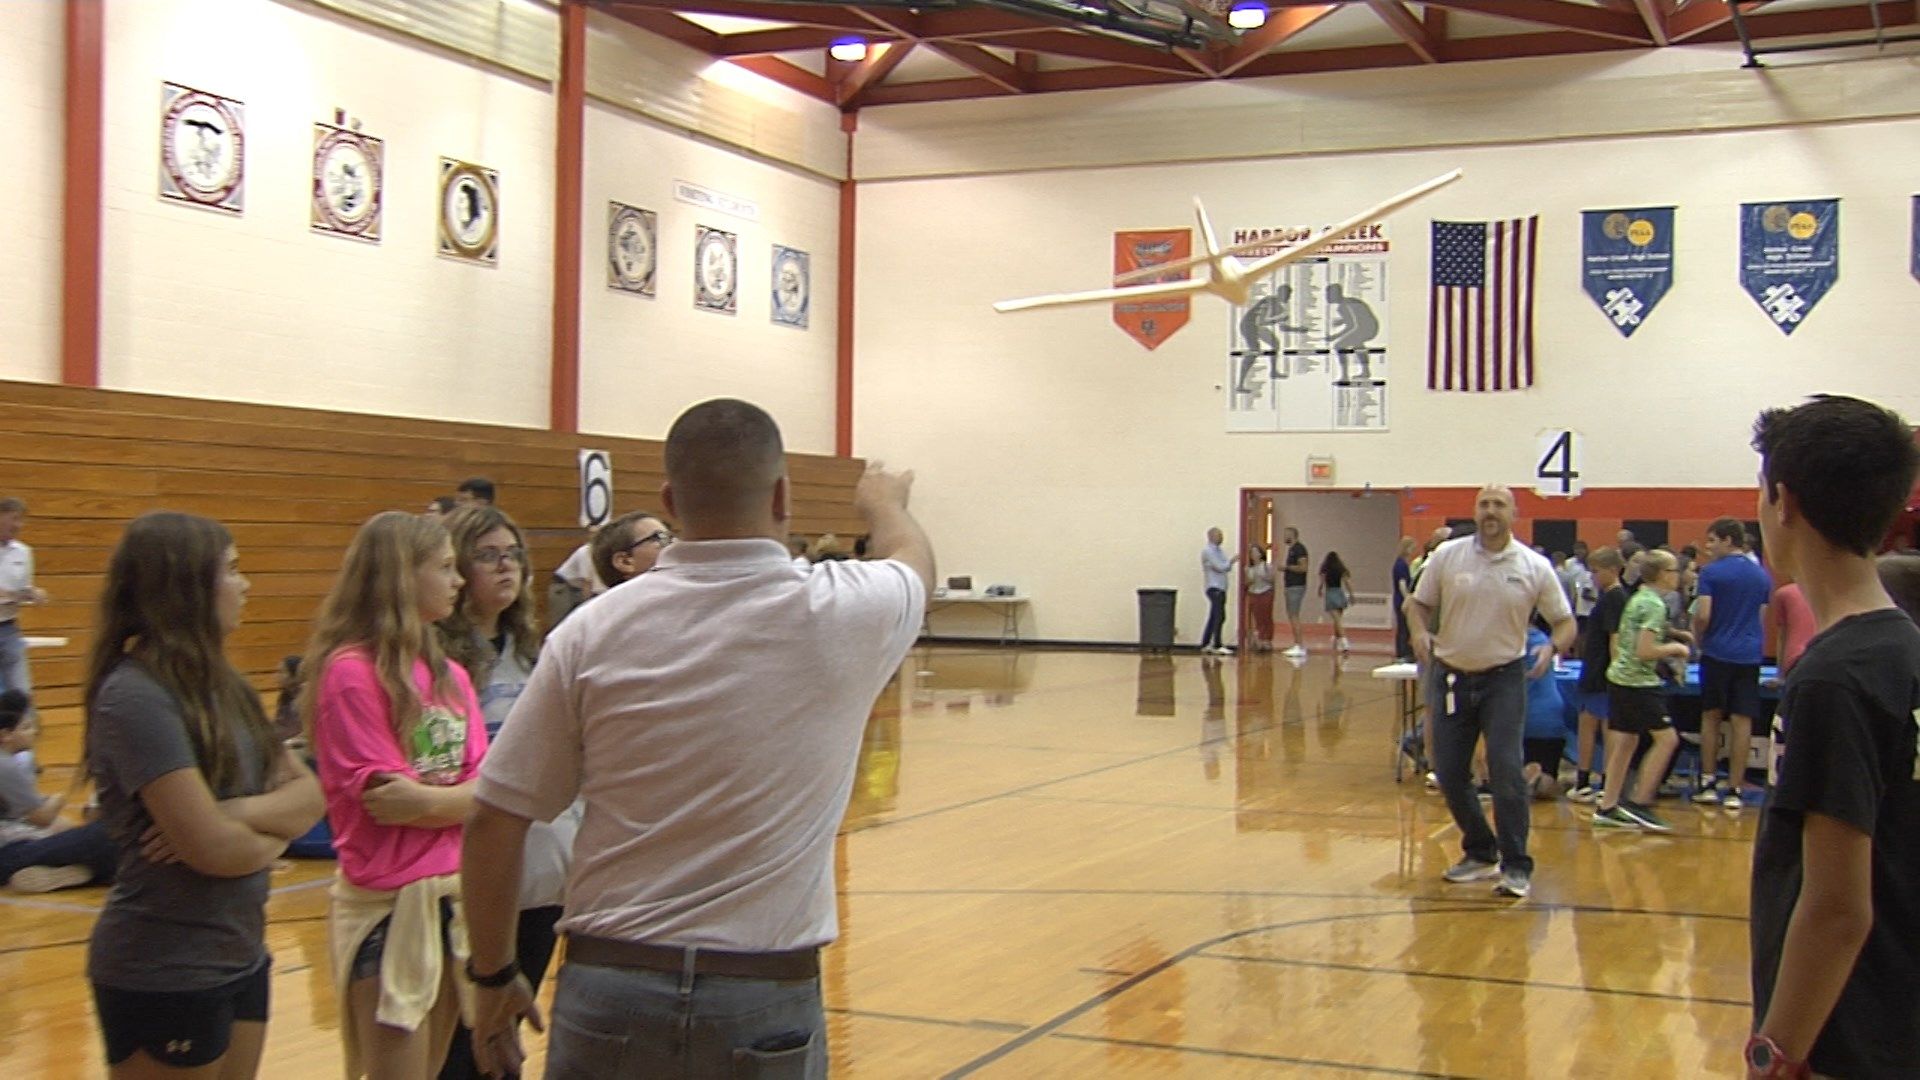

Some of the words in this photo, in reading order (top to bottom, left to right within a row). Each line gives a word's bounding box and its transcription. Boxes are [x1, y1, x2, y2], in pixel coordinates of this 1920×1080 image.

[1321, 223, 1383, 240] EEK
[584, 453, 610, 526] 6
[1537, 431, 1579, 493] 4
